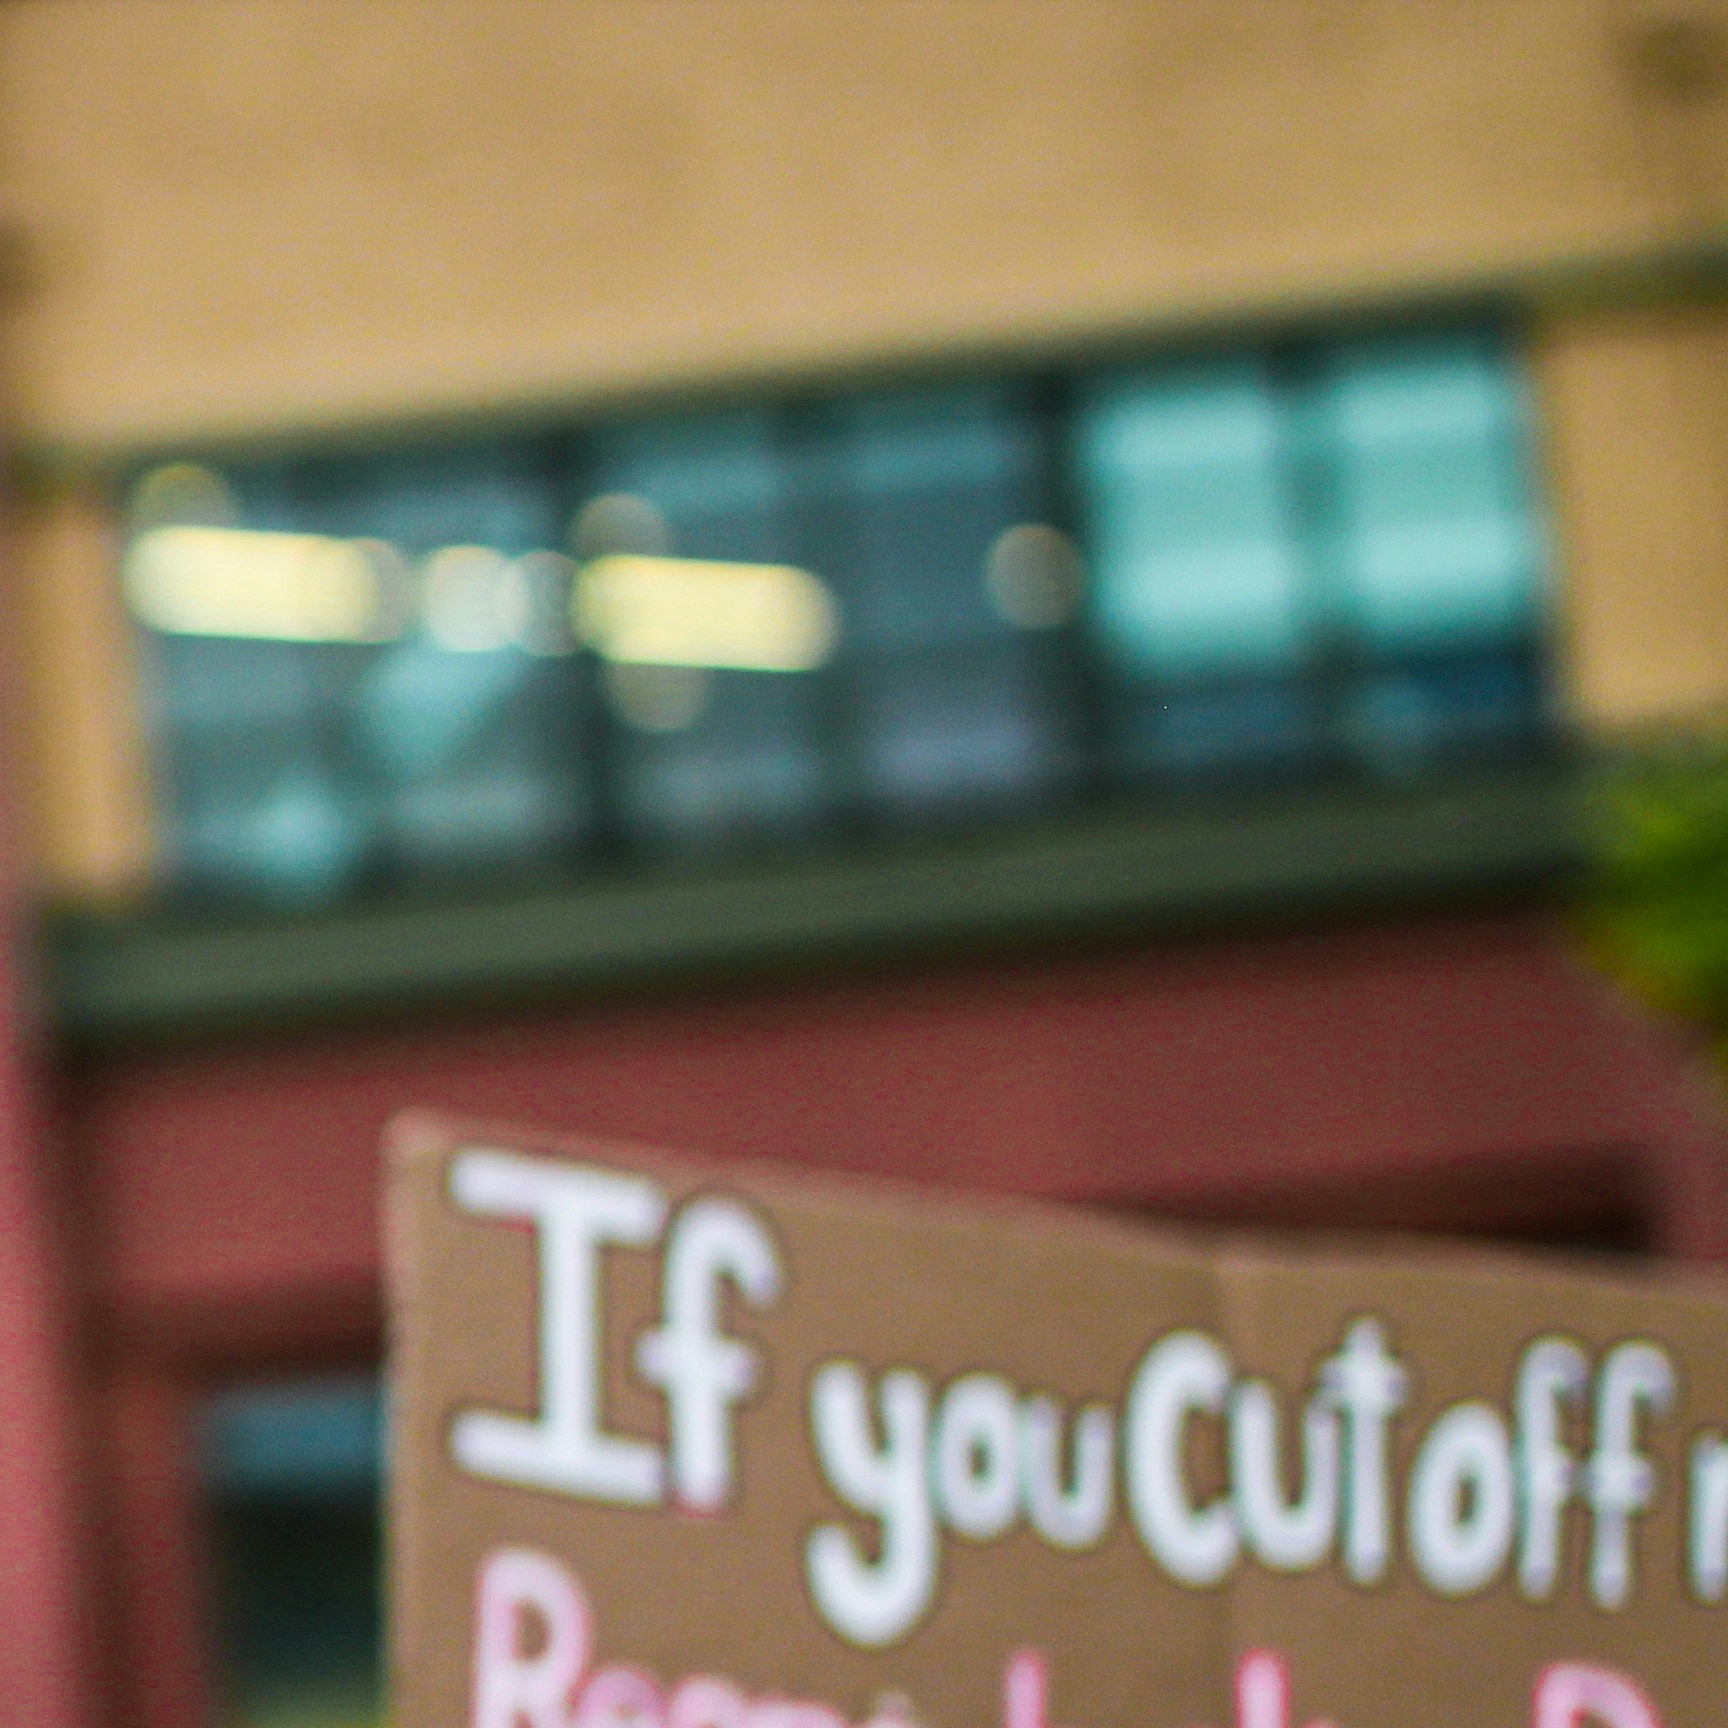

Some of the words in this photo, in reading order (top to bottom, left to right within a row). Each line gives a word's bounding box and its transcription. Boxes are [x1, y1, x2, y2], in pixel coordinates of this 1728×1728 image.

[447, 1145, 782, 1515] If
[806, 1360, 1116, 1647] you
[1408, 1338, 1676, 1608] off
